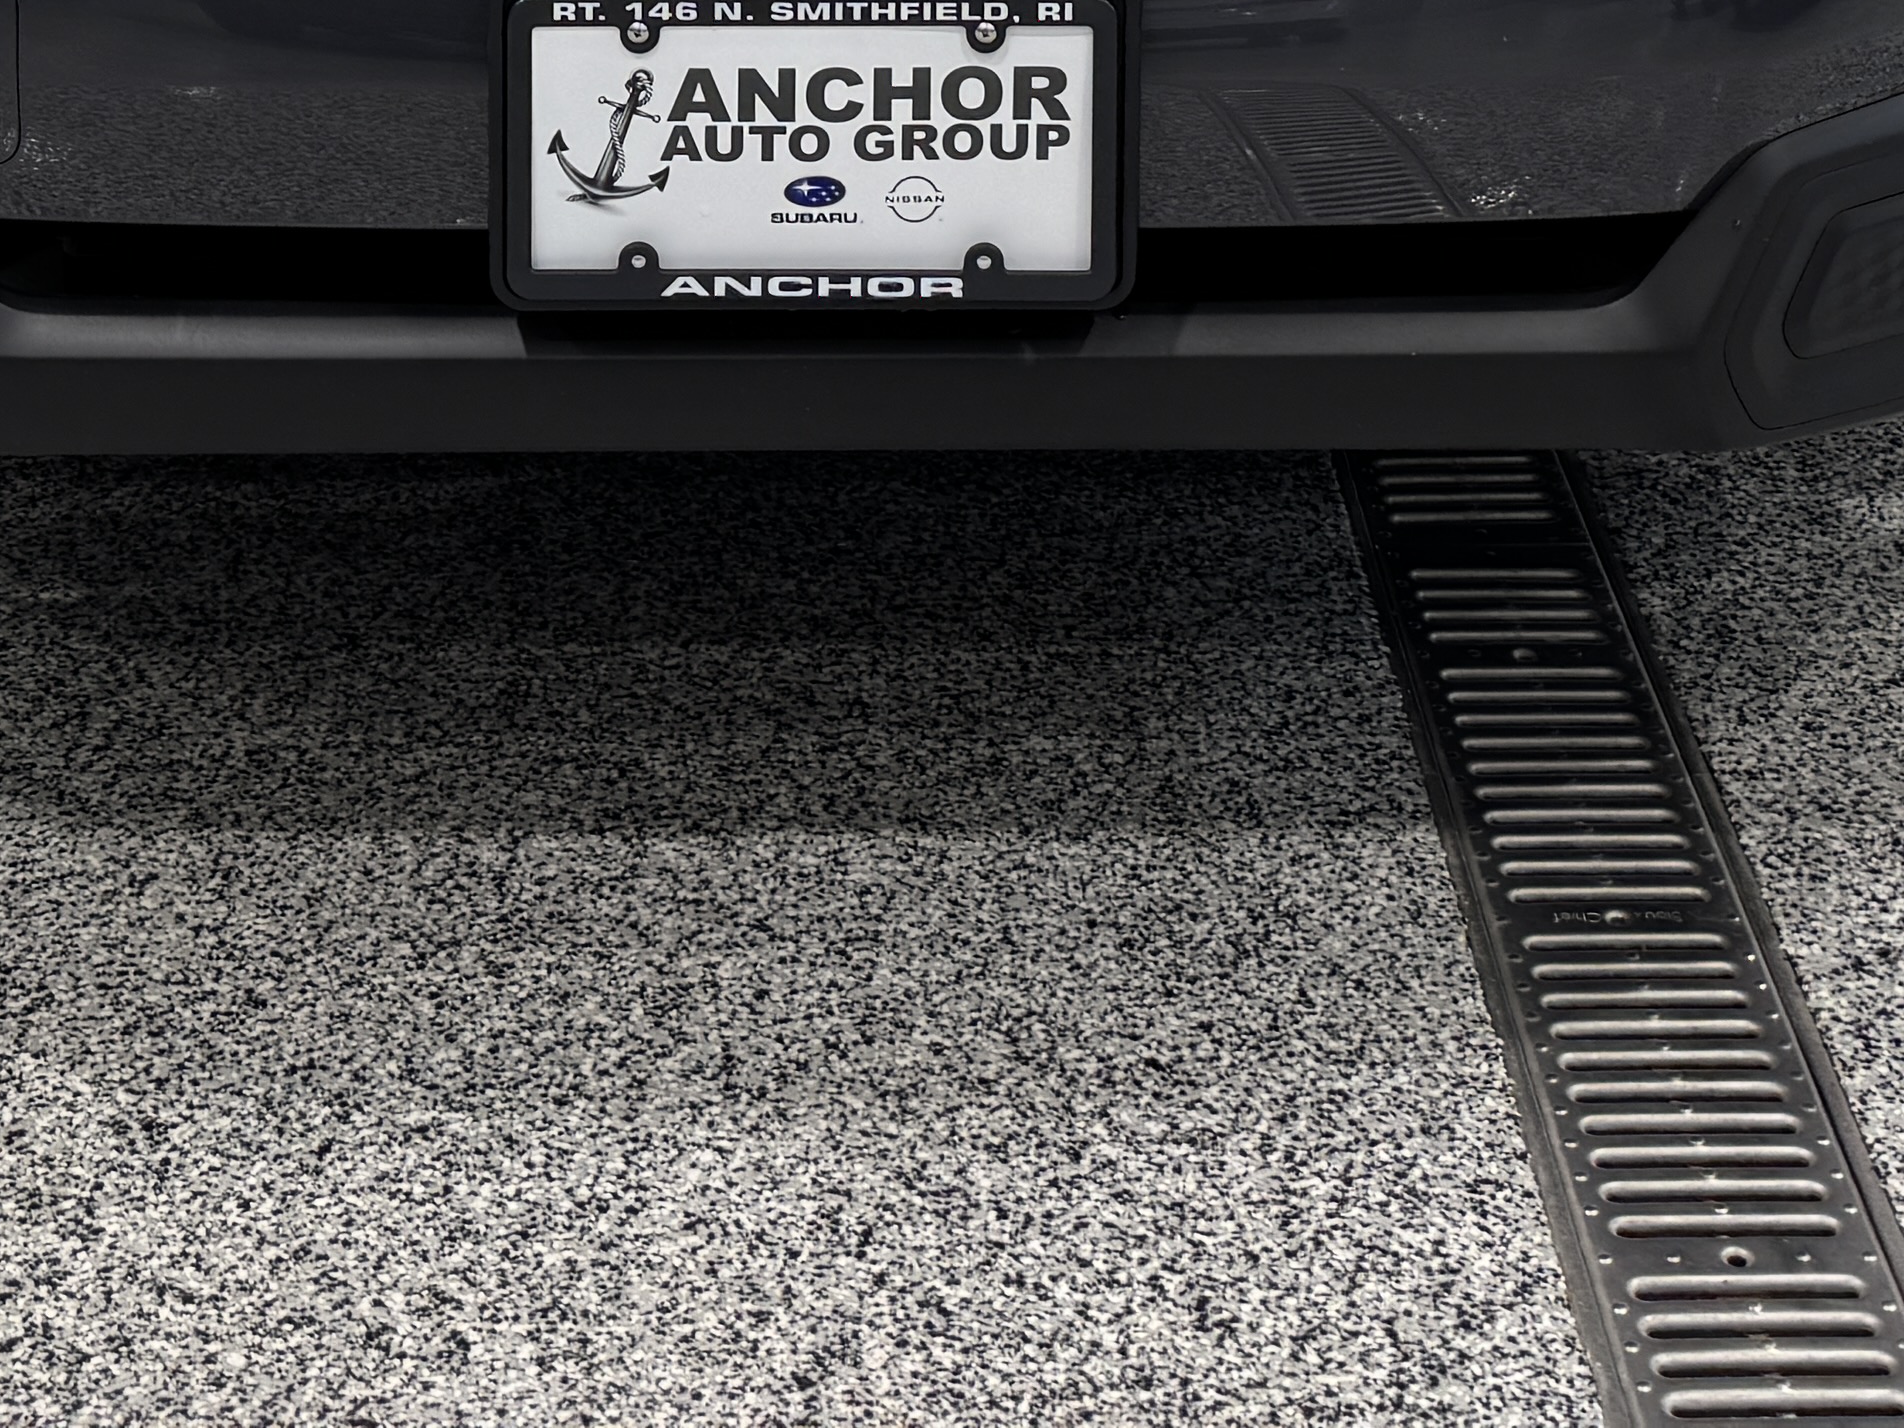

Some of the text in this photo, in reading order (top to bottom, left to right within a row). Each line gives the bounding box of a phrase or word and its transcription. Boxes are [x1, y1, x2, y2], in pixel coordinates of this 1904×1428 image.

[552, 1, 1073, 23] RT. 146 N. SMITHFIELD, RI
[666, 66, 1071, 122] ANCHOR
[660, 123, 1071, 162] AUTO GROUP
[884, 195, 945, 204] NISSAN
[770, 212, 858, 224] SUBARU
[661, 275, 964, 298] ANCHOR
